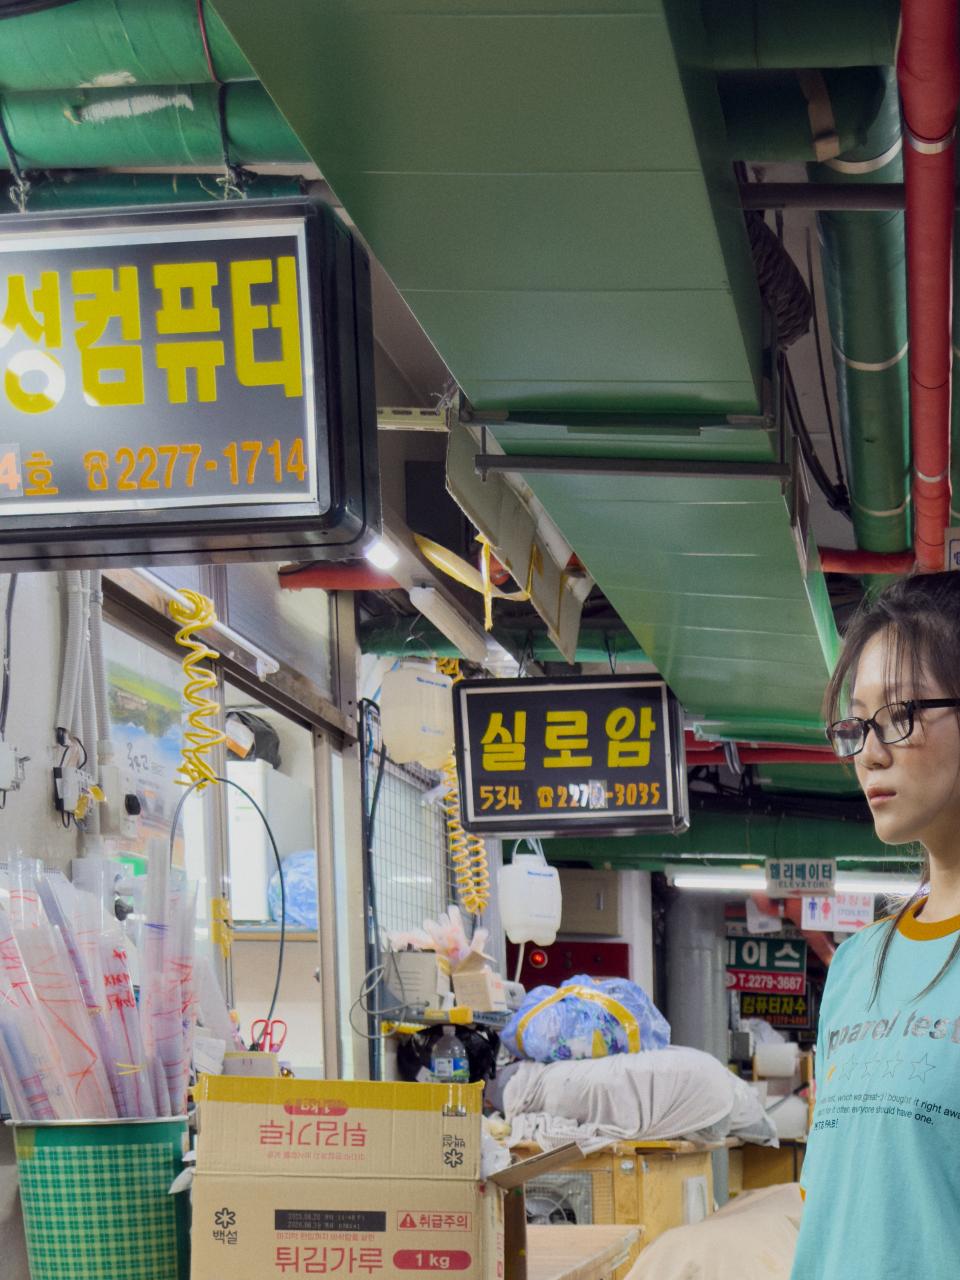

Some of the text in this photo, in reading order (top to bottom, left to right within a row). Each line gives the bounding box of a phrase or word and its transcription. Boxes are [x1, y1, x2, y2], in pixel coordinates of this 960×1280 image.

[115, 438, 308, 491] 2277-1714
[480, 706, 657, 772] 실로암
[479, 782, 661, 811] 534 227-3035
[920, 1100, 942, 1115] right
[914, 1112, 935, 1126] one.
[258, 1119, 368, 1147] 튀김가루
[419, 1214, 469, 1229] 취급주의
[212, 1229, 239, 1245] 백설
[274, 1246, 384, 1274] 튀김가루
[429, 1254, 450, 1268] kg
